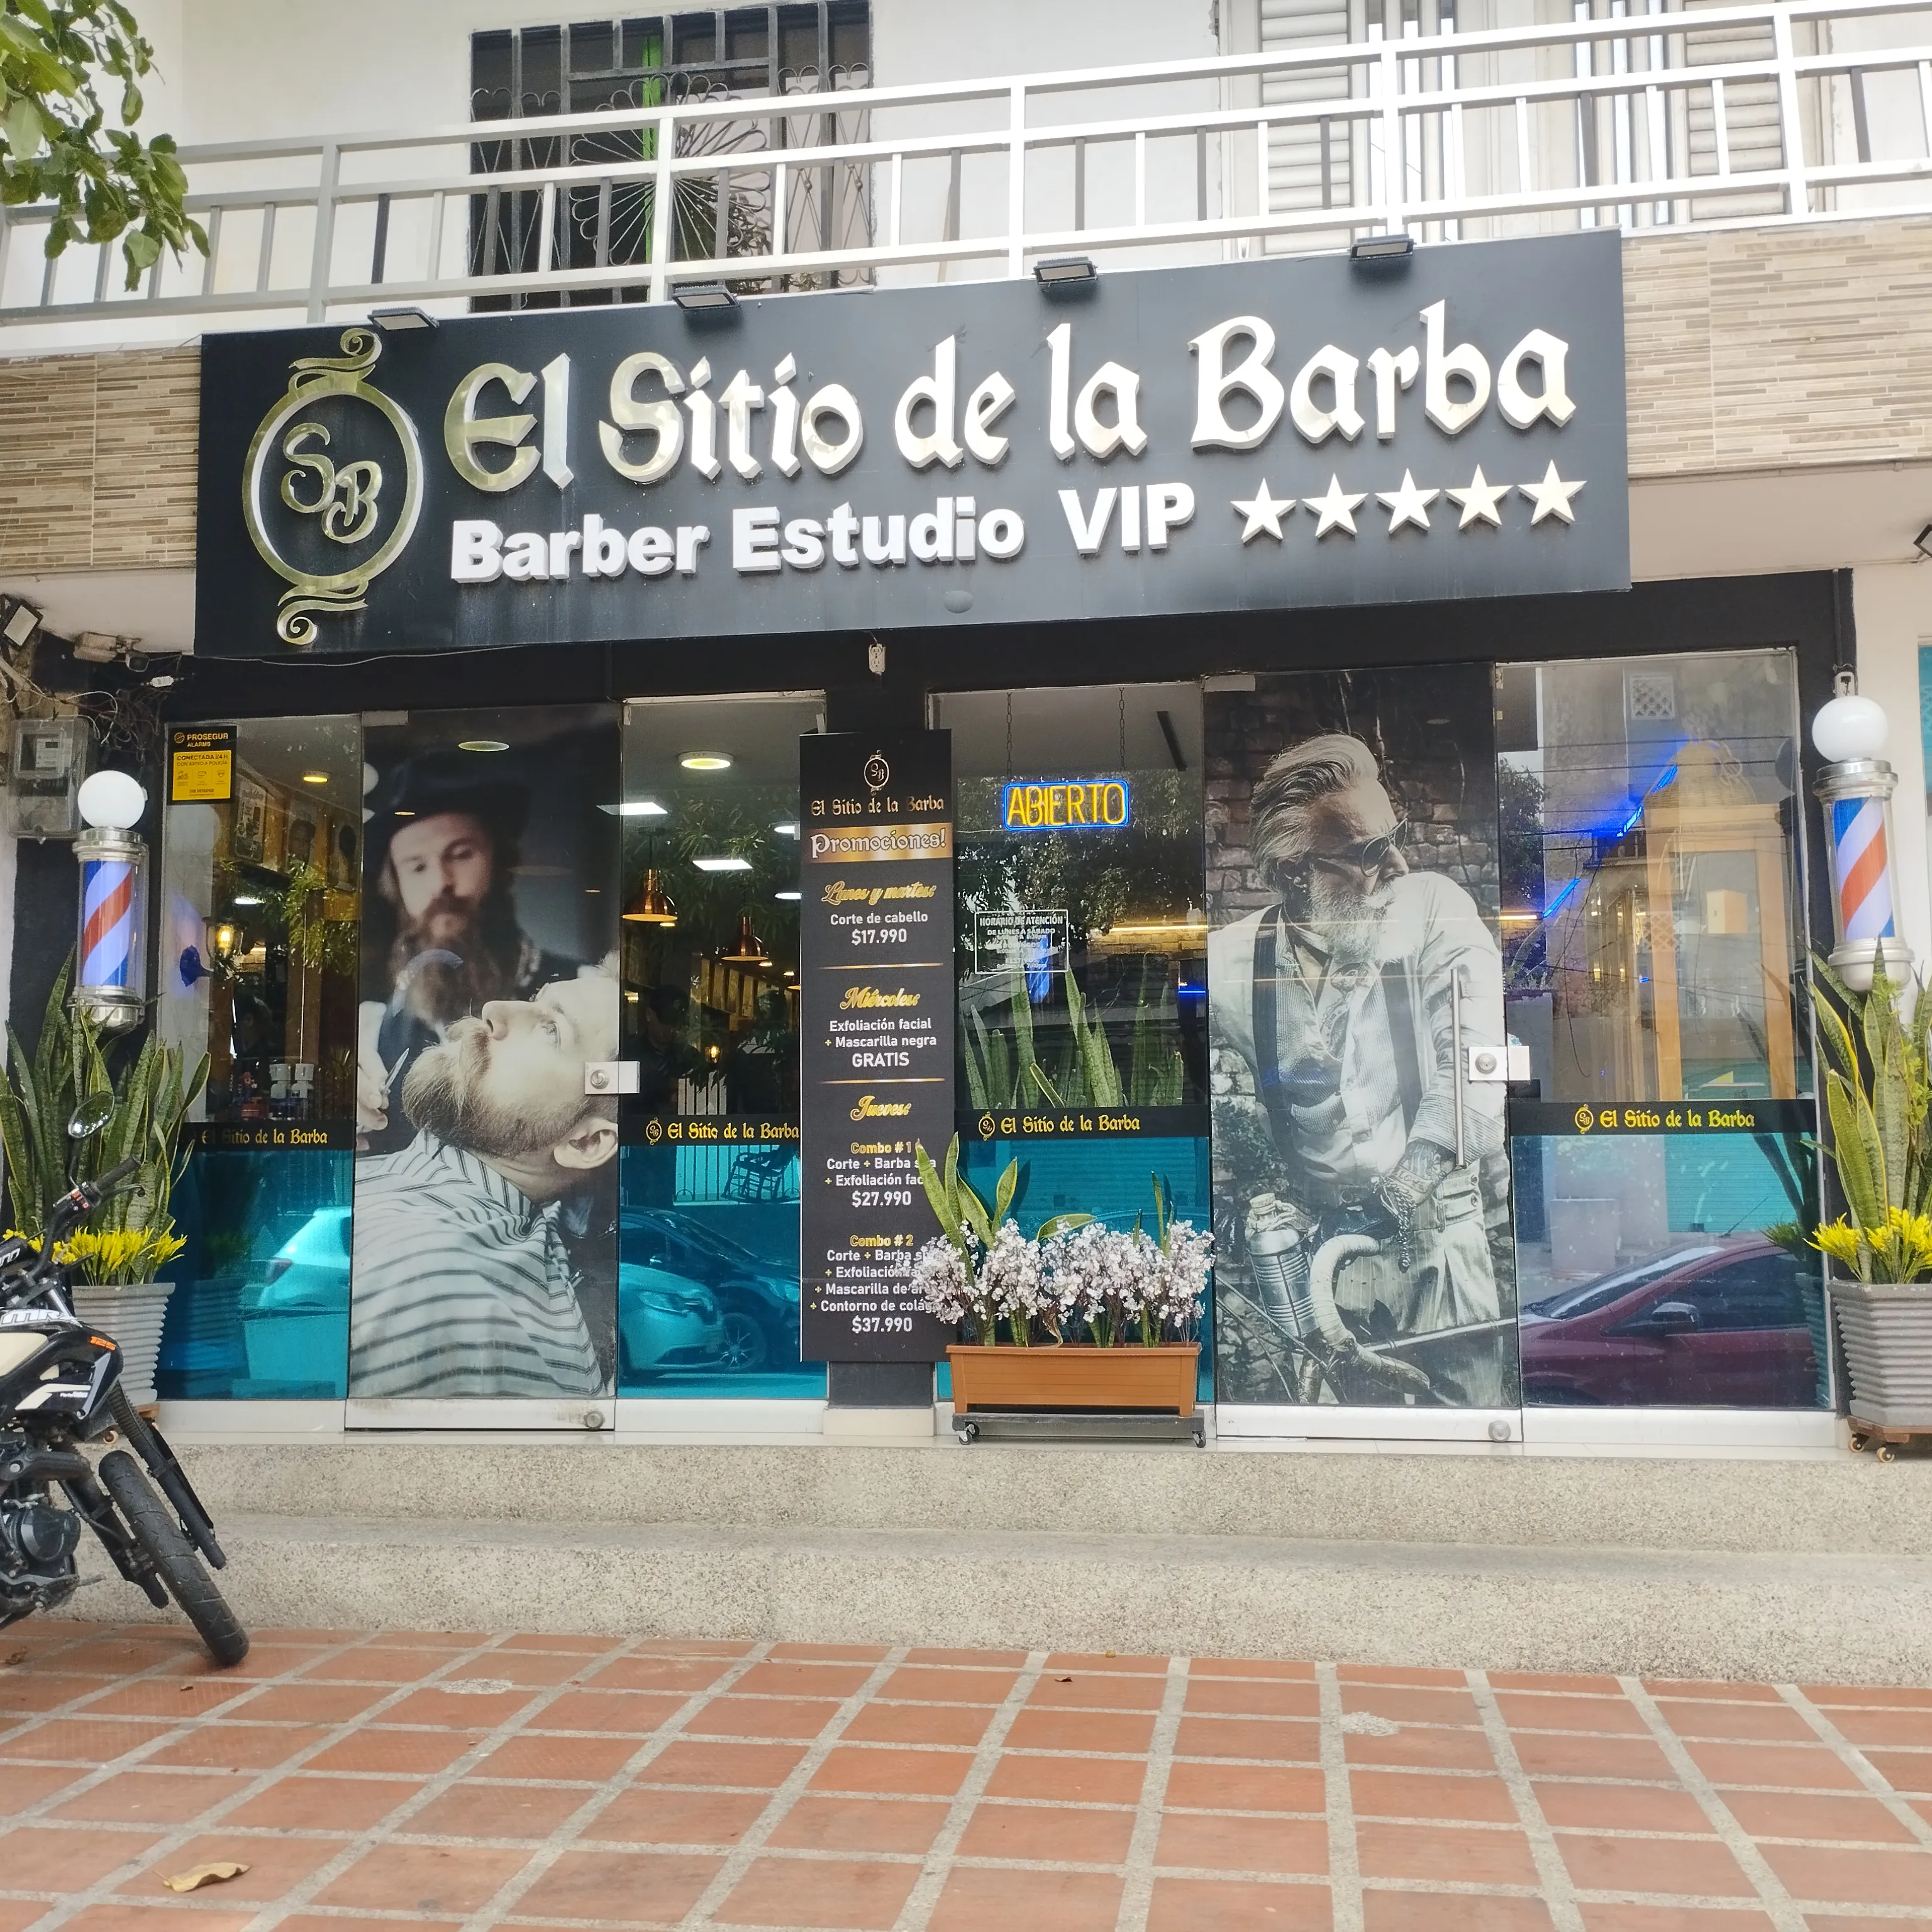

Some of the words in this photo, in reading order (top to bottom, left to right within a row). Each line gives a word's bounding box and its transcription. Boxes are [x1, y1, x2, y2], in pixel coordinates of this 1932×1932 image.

[444, 352, 574, 492] El
[599, 352, 863, 483] Sitio
[894, 335, 1016, 469] de
[1046, 323, 1148, 460] la
[1188, 299, 1577, 450] Barba
[451, 513, 711, 583] Barber
[733, 496, 1025, 572] Estudio
[1058, 482, 1195, 554] VIP
[811, 800, 825, 816] El
[832, 798, 862, 815] Sitio
[868, 797, 881, 814] de
[887, 796, 899, 813] la
[906, 795, 944, 811] Barba
[1008, 784, 1124, 826] ABIERTO
[810, 827, 947, 858] Promociones!
[821, 880, 870, 906] Lunes
[869, 887, 884, 906] y
[830, 914, 863, 925] Corte
[867, 913, 881, 924] de
[885, 911, 928, 923] cabello
[980, 918, 1013, 926] HORARIO
[1014, 917, 1024, 925] DE
[1026, 914, 1063, 924] ATENCIÓN
[852, 928, 907, 946] $17.990
[830, 1018, 895, 1031] Exfoliación
[899, 1018, 931, 1030] facial
[835, 1035, 898, 1048] Mascarilla
[901, 1036, 937, 1048] negra
[852, 1052, 909, 1068] GRATIS
[1001, 1117, 1017, 1133] El
[1023, 1116, 1055, 1133] Sitio
[1060, 1115, 1074, 1132] de
[1080, 1114, 1092, 1131] la
[1098, 1113, 1140, 1131] Barba
[1600, 1110, 1618, 1128] El
[1624, 1109, 1660, 1128] Sitio
[1666, 1109, 1682, 1128] de
[1687, 1109, 1702, 1127] la
[1708, 1109, 1755, 1127] Barba
[255, 1128, 268, 1143] de
[274, 1128, 285, 1143] la
[290, 1128, 328, 1144] Barba
[667, 1122, 683, 1139] El
[688, 1122, 718, 1139] Sitio
[724, 1122, 737, 1138] de
[743, 1122, 755, 1138] la
[760, 1122, 799, 1139] Barba
[850, 1141, 892, 1154] Combo
[894, 1141, 904, 1153] #
[906, 1141, 911, 1153] 1
[826, 1158, 860, 1170] Corte
[875, 1157, 911, 1169] Barba
[914, 1159, 936, 1169] sa
[836, 1173, 901, 1186] Exfoliación
[906, 1173, 925, 1185] fac
[852, 1191, 911, 1208] $27.990
[850, 1235, 891, 1246] Combo
[894, 1235, 903, 1246] #
[906, 1235, 914, 1246] 2
[827, 1250, 860, 1261] Corte
[875, 1250, 911, 1261] Barba
[826, 1283, 889, 1295] Mascarilla
[892, 1282, 908, 1294] de
[821, 1300, 877, 1312] Contorno
[881, 1299, 895, 1311] de
[899, 1297, 933, 1314] colág
[852, 1315, 913, 1333] $37.990
[90, 1336, 116, 1352] 125
